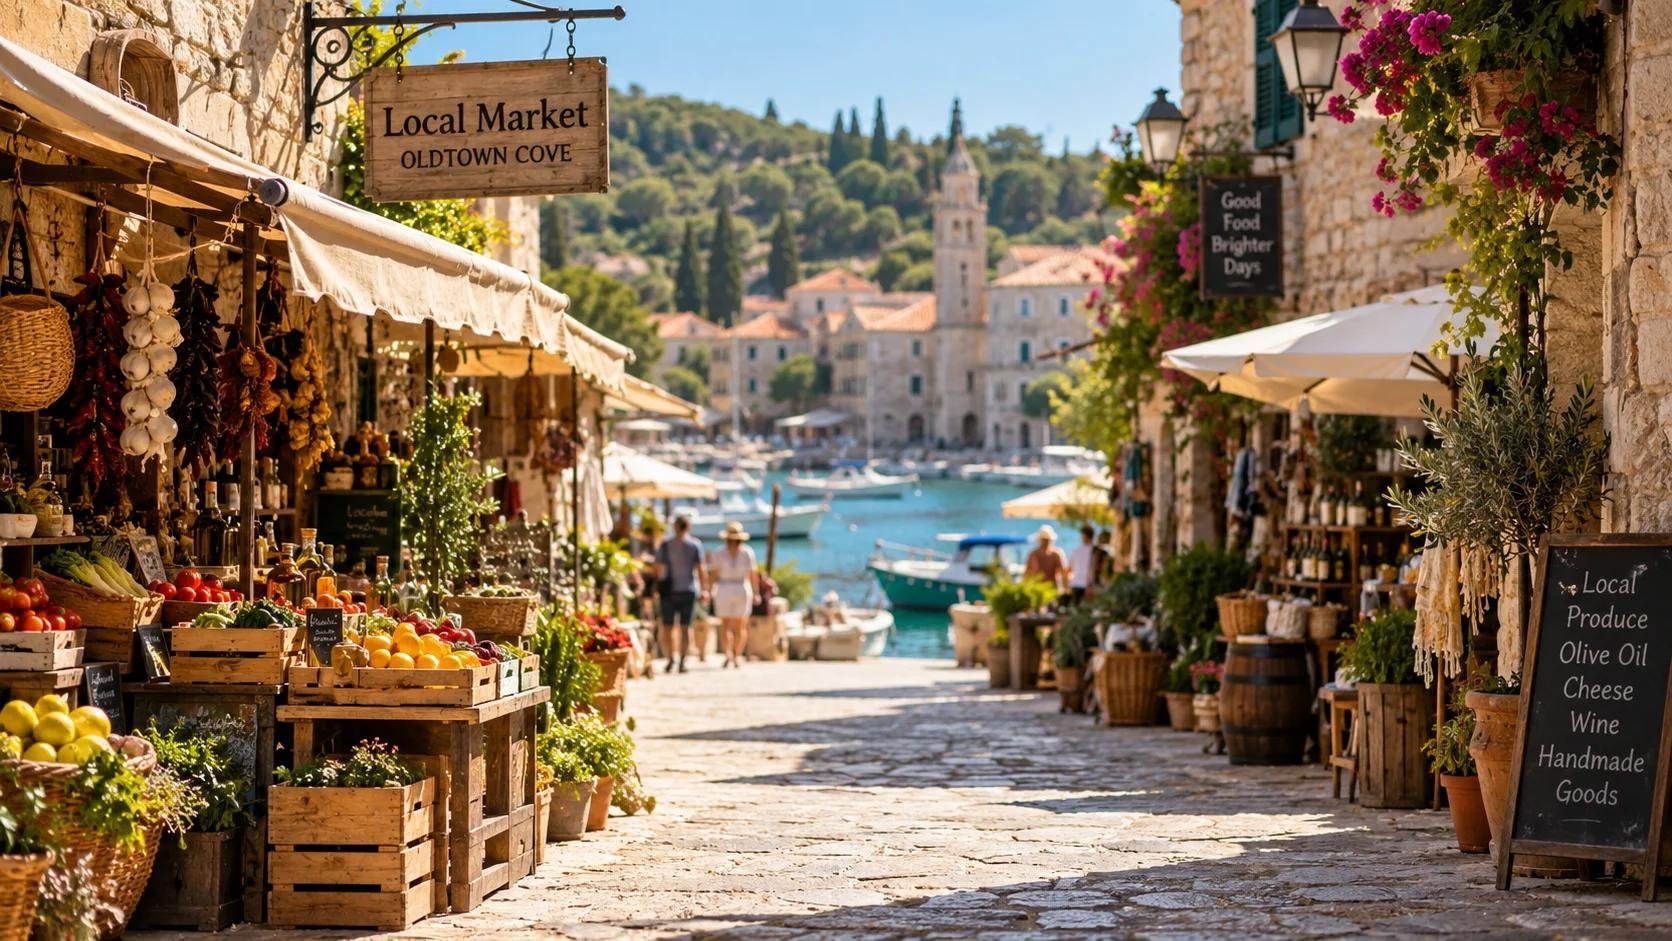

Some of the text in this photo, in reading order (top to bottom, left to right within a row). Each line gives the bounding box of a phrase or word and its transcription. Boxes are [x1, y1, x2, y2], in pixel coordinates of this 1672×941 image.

[383, 98, 589, 137] Local Market
[401, 144, 573, 169] OLDTOWN COVE
[1221, 190, 1262, 209] Good
[1223, 213, 1261, 231] Food
[1211, 235, 1274, 257] Brighter
[1224, 257, 1262, 279] Days
[1582, 571, 1637, 594] Local
[1566, 605, 1648, 629] Produce
[1559, 641, 1647, 666] Olive Oil
[1563, 675, 1634, 700] Cheese
[1570, 710, 1620, 734] Wine
[1538, 744, 1645, 772] Handmade
[1555, 779, 1618, 805] Goods
